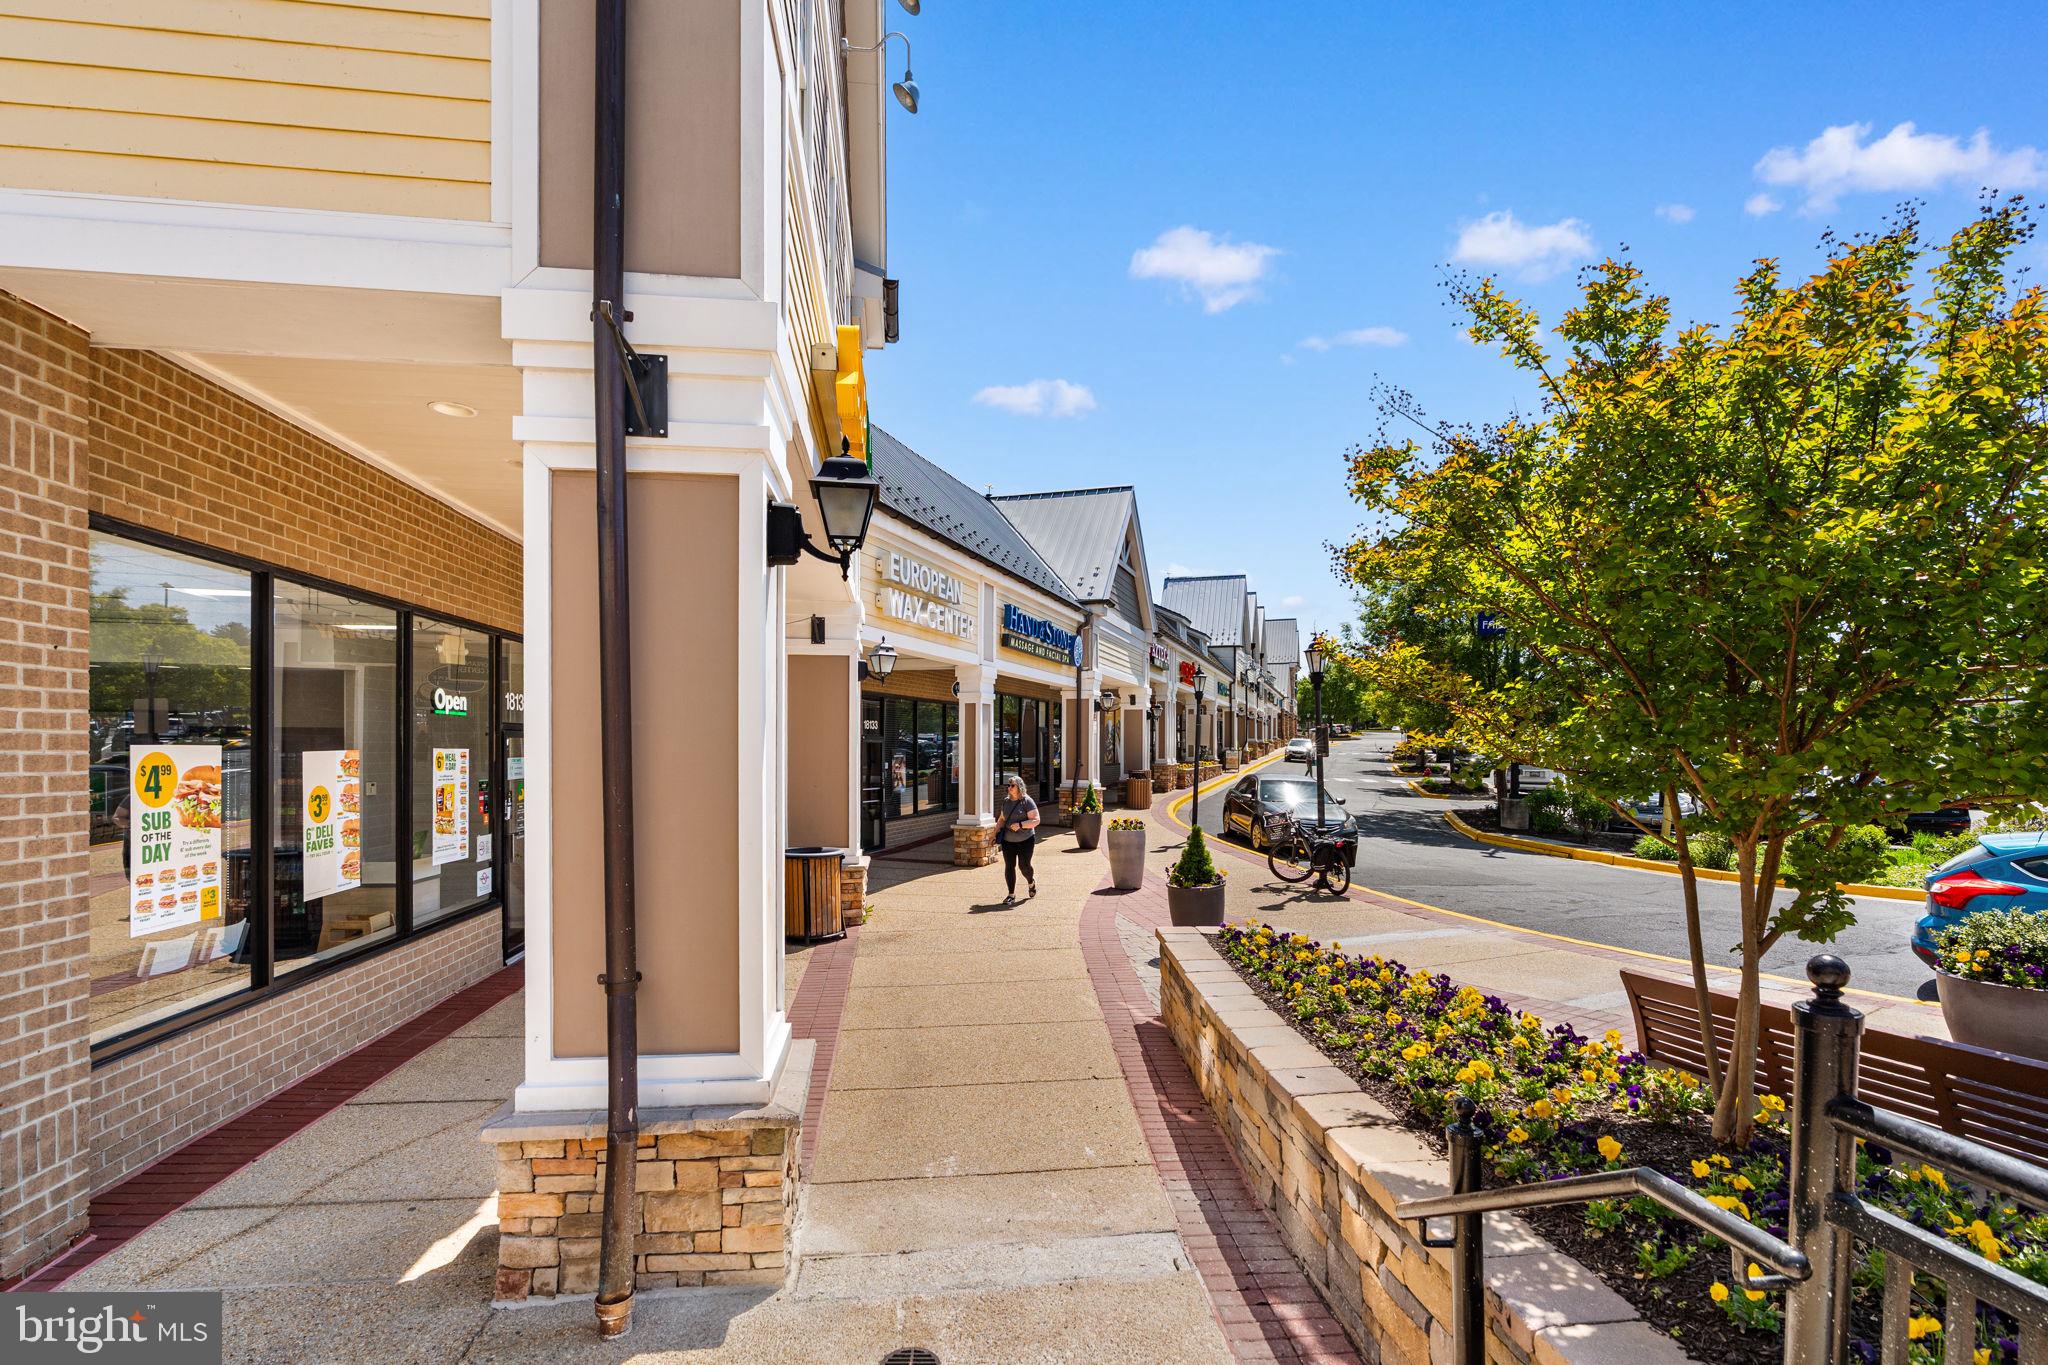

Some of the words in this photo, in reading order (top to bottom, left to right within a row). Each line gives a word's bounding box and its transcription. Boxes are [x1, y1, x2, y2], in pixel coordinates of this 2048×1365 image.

[890, 552, 964, 605] EUROPEAN
[888, 587, 923, 623] WAX
[927, 602, 974, 639] CENTER
[1010, 604, 1038, 639] HAND
[1046, 620, 1072, 650] STONE
[1010, 637, 1034, 654] MASSAGE
[1036, 645, 1046, 657] AND
[1046, 648, 1061, 661] FACIAL
[1062, 653, 1070, 664] SPA
[434, 688, 468, 715] Open
[863, 719, 879, 730] 18133
[141, 811, 171, 832] SUB
[316, 824, 333, 839] DELI
[141, 833, 154, 843] OF
[155, 831, 172, 841] THE
[306, 837, 334, 853] FAVES
[142, 842, 172, 865] DAY
